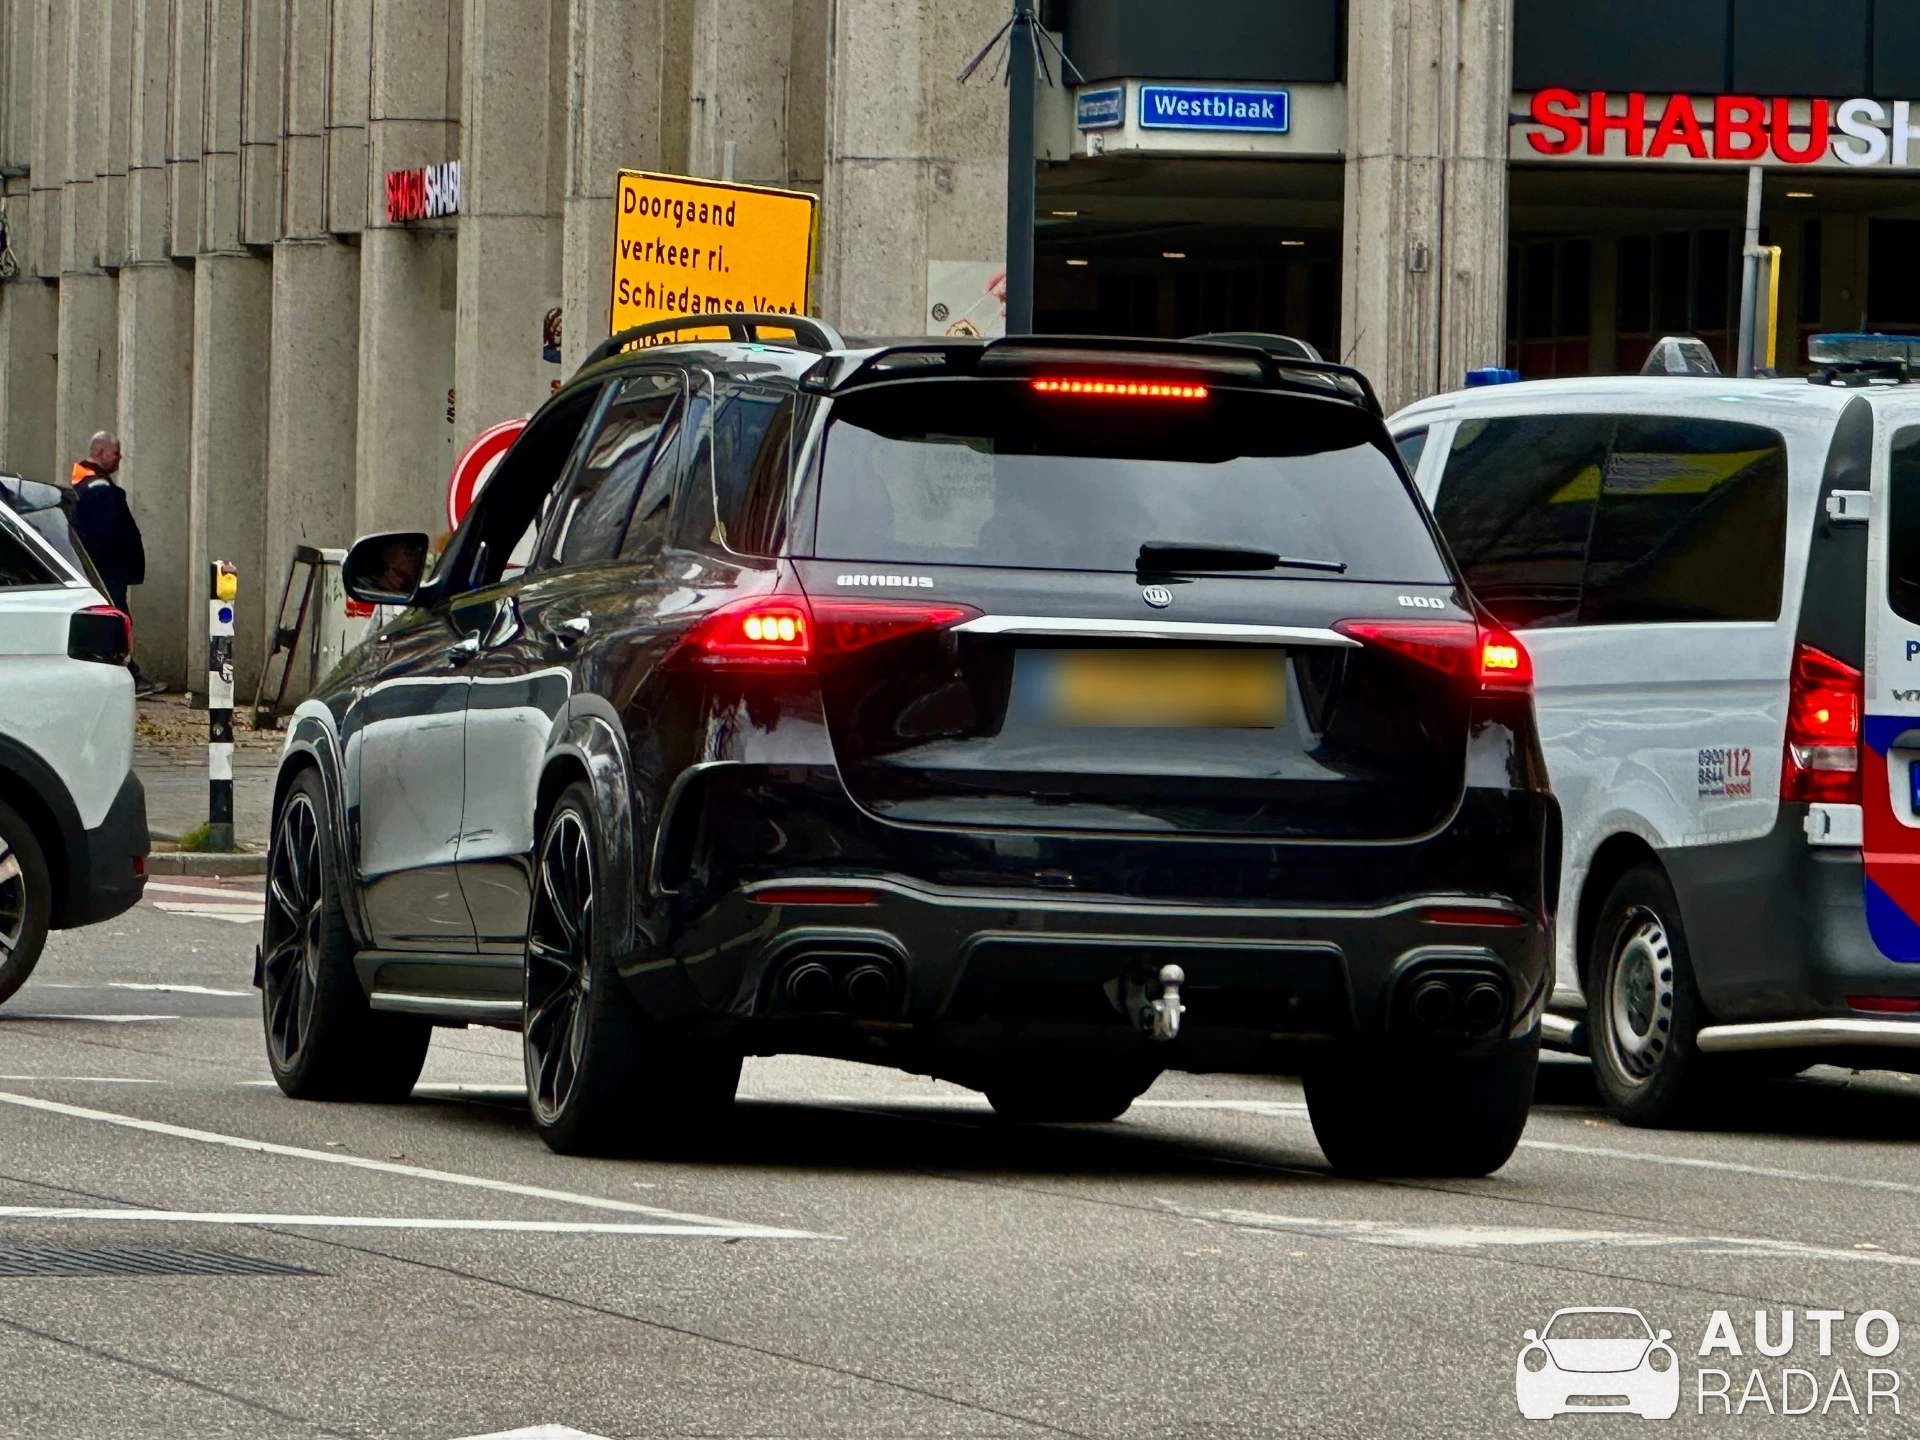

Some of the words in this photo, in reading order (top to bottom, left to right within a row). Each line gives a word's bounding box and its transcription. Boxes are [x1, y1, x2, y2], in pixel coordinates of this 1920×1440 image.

[1154, 94, 1275, 119] Westblaak
[624, 186, 736, 229] Doorgaand
[620, 236, 701, 269] verkeer
[708, 244, 730, 274] ri.
[618, 277, 745, 315] Schiedamse
[1726, 748, 1751, 777] 112
